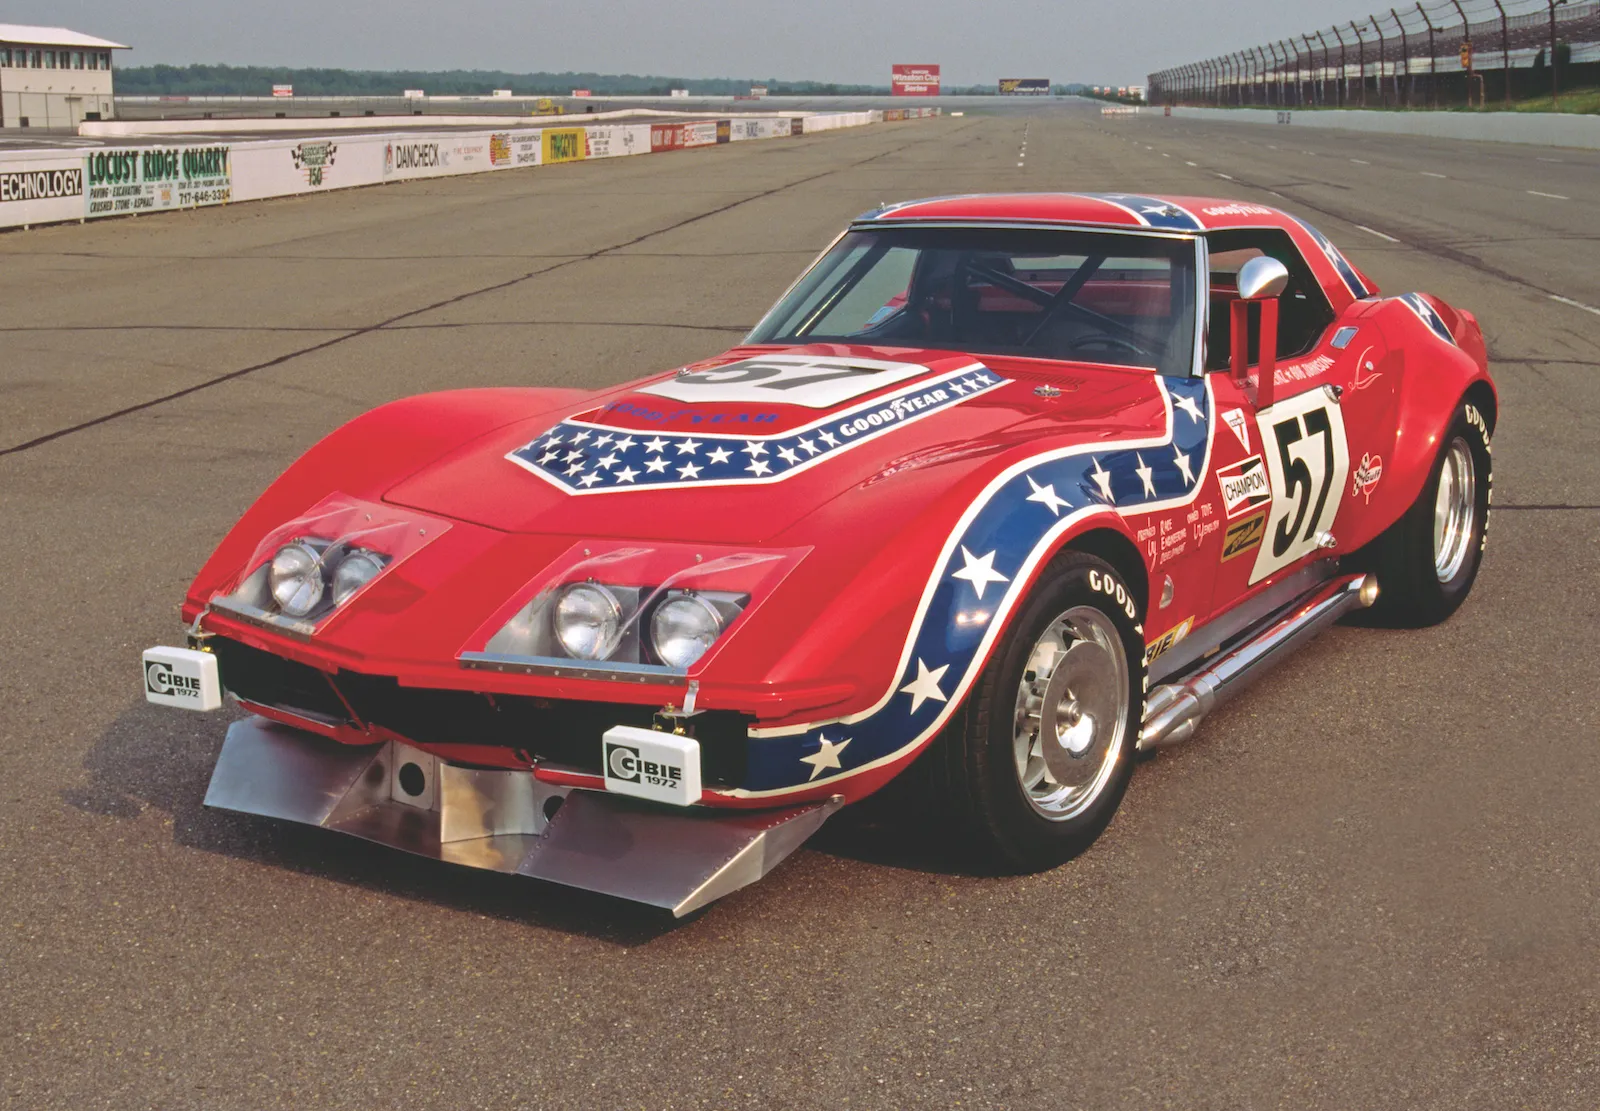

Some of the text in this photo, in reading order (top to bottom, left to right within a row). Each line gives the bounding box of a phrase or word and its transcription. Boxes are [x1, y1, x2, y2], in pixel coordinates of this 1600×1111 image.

[925, 74, 940, 82] Cup
[396, 144, 439, 168] DANCHECK
[88, 147, 229, 185] LOCUST RIDGE QUARRY
[309, 167, 322, 185] 150
[90, 187, 109, 198] PAVING
[113, 185, 142, 196] EXCAVATING
[179, 189, 230, 204] 717-646-3324
[90, 201, 113, 213] CRUSHED
[114, 199, 130, 210] STONE
[133, 197, 154, 208] ASPHALT
[675, 361, 887, 390] 57
[1272, 406, 1334, 557] 57
[1364, 469, 1381, 483] Gulf
[1225, 471, 1266, 500] CHAMPION
[1089, 570, 1136, 619] GOOD
[157, 672, 200, 690] CIBIE
[176, 688, 199, 698] 1972
[621, 757, 681, 780] CIBIE
[645, 775, 677, 789] 1972
